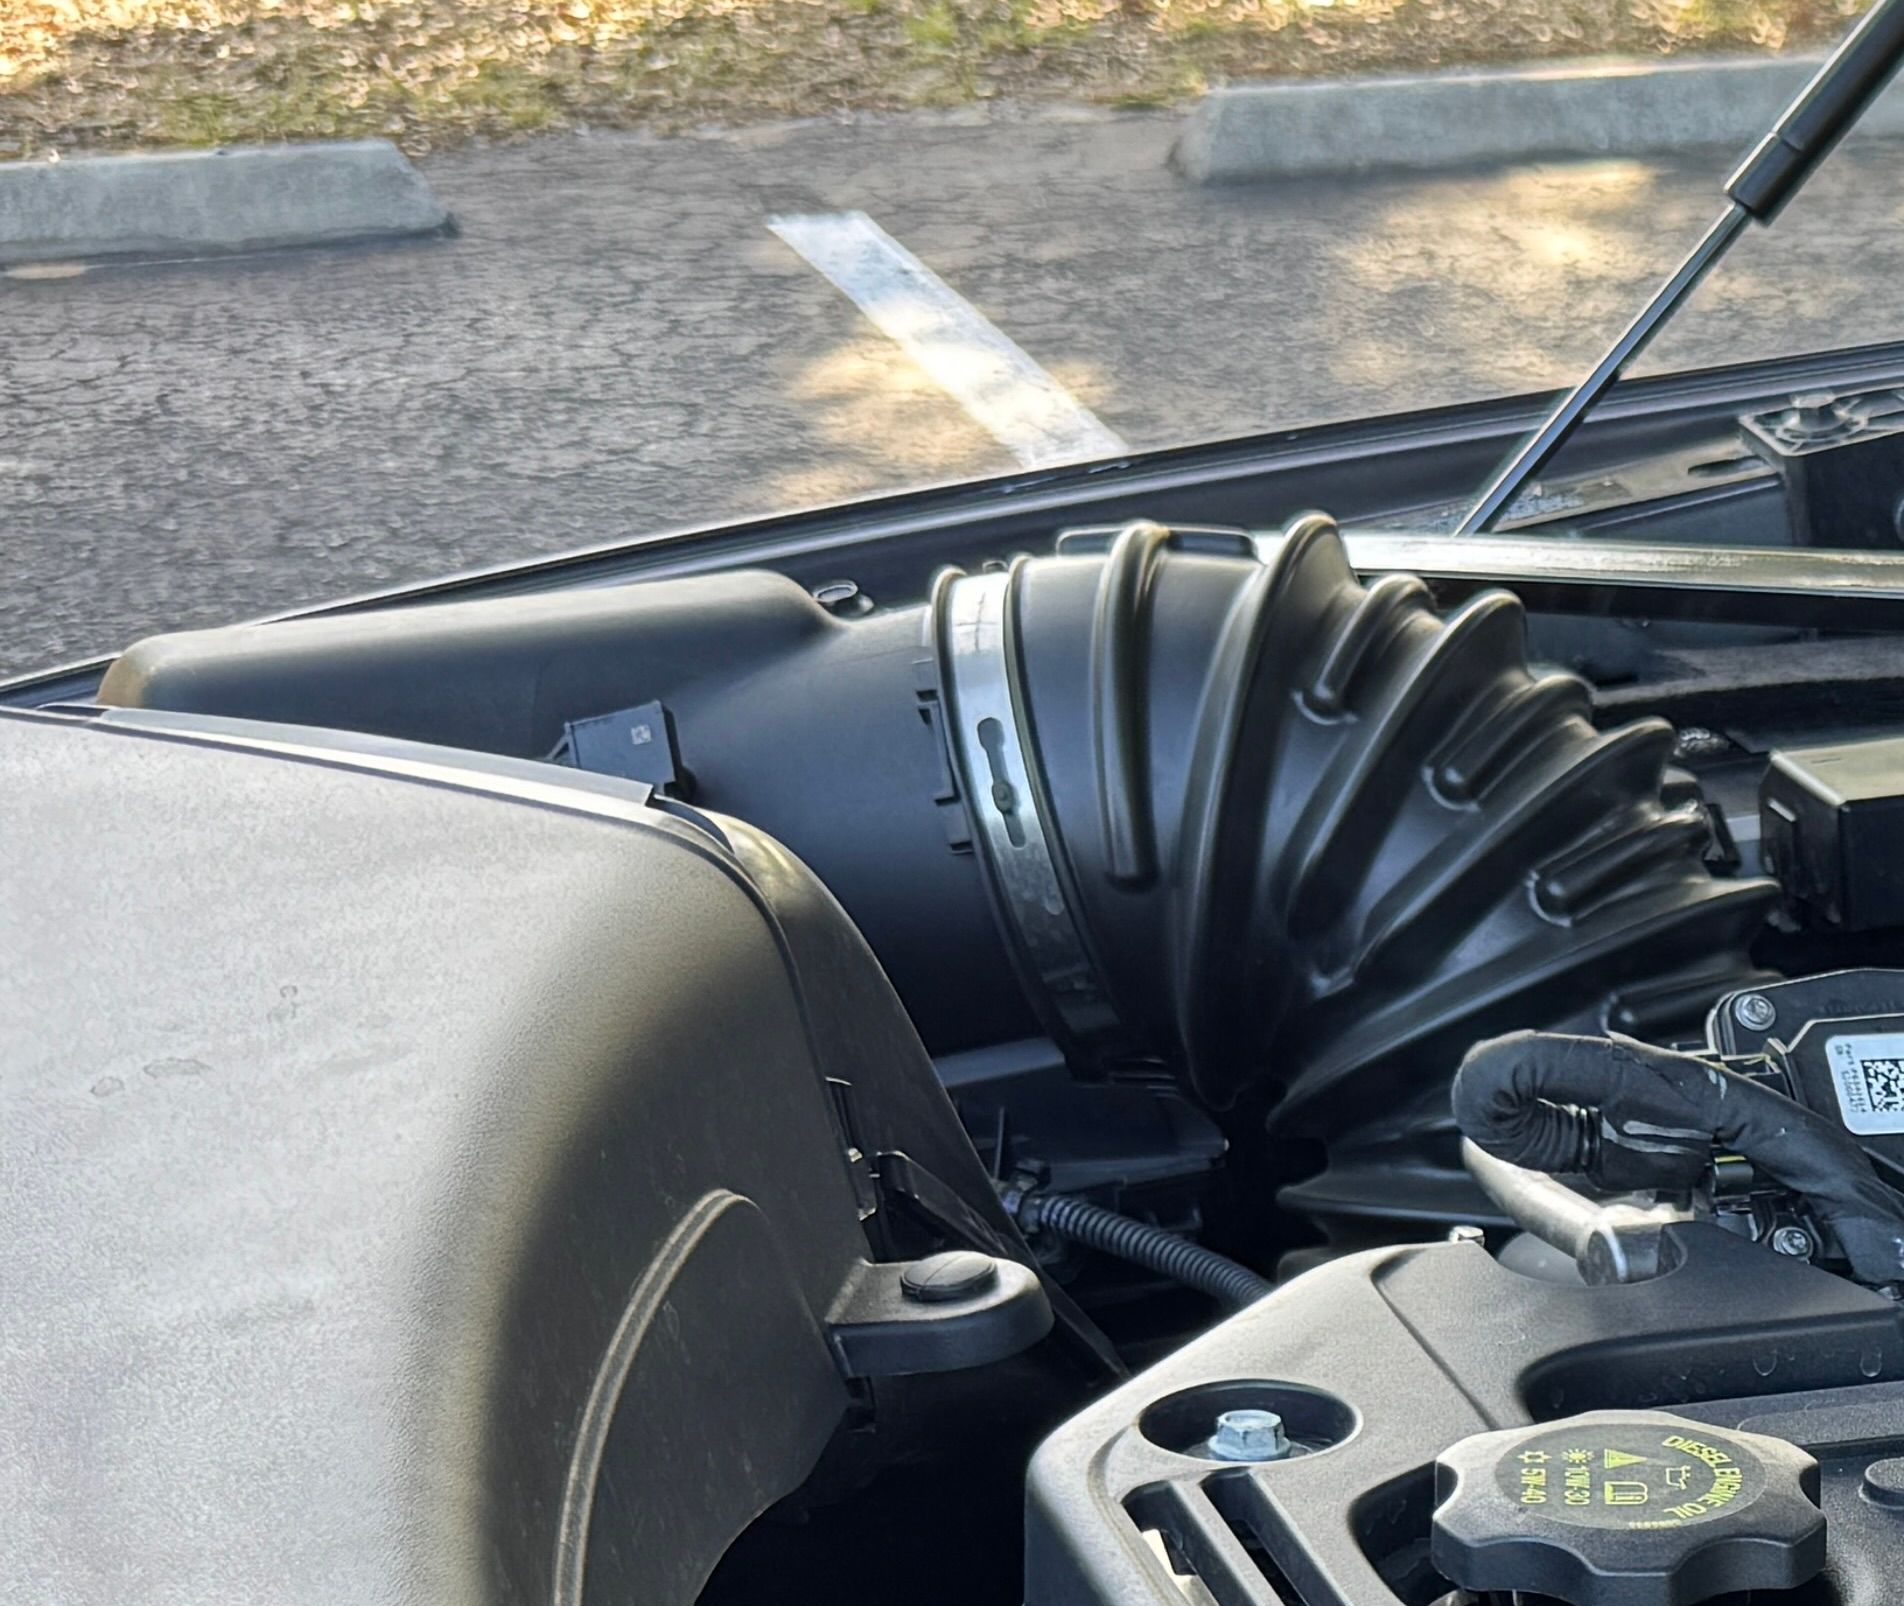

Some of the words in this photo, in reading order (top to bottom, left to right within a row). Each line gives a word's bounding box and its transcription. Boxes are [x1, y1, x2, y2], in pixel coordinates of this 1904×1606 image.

[1662, 1435, 1732, 1467] DIESEL
[1520, 1467, 1547, 1504] 5W-40
[1564, 1465, 1591, 1506] 10W-30
[1699, 1467, 1744, 1507] ENGINE
[1663, 1502, 1707, 1519] OIL
